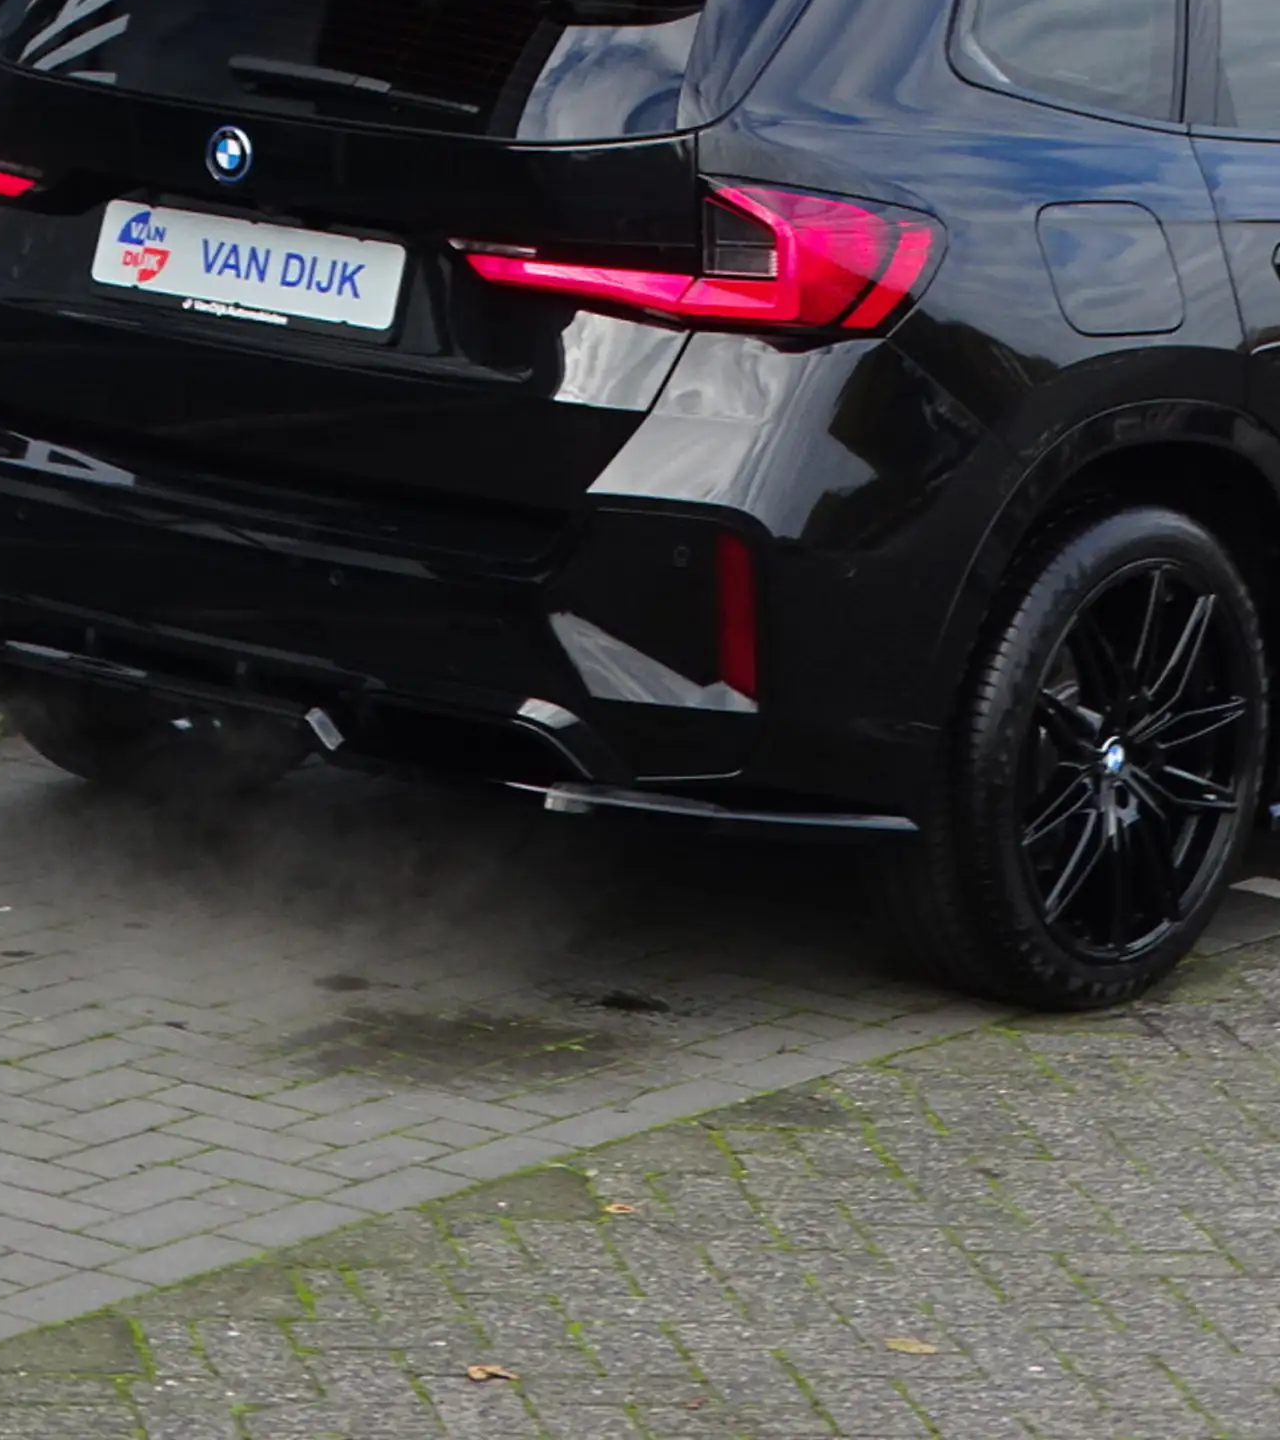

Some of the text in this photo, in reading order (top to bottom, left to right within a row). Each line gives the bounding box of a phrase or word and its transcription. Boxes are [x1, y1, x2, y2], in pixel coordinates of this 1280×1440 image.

[130, 220, 167, 244] VAN
[121, 249, 161, 272] DIJK
[201, 237, 366, 300] VAN DIJK
